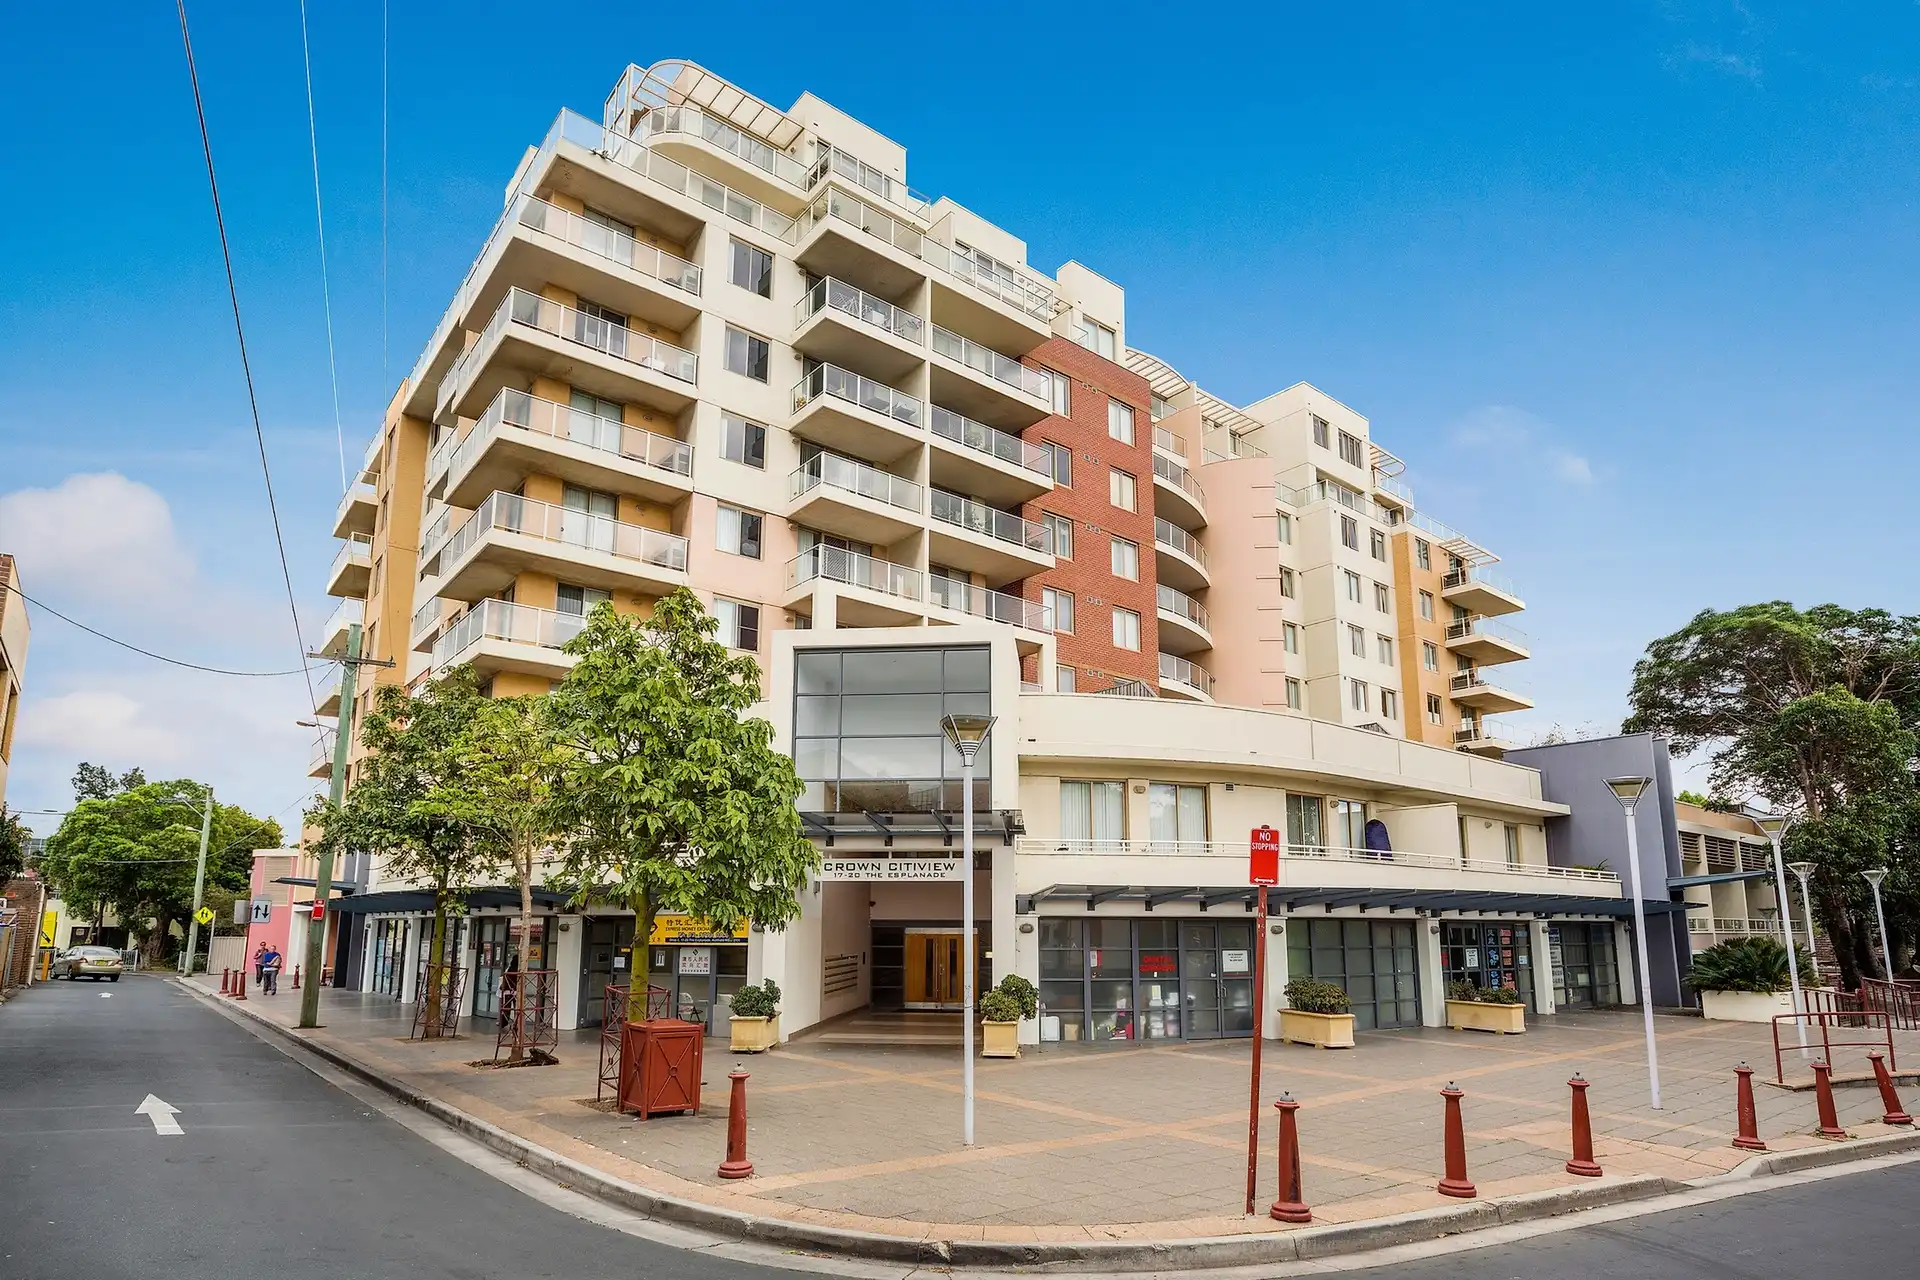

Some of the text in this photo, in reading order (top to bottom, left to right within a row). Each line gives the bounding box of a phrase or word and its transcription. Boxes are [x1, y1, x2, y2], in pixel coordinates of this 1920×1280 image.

[1259, 831, 1271, 841] NO
[1251, 842, 1279, 852] STOPPING
[823, 862, 956, 872] CROWN CITIVIEW
